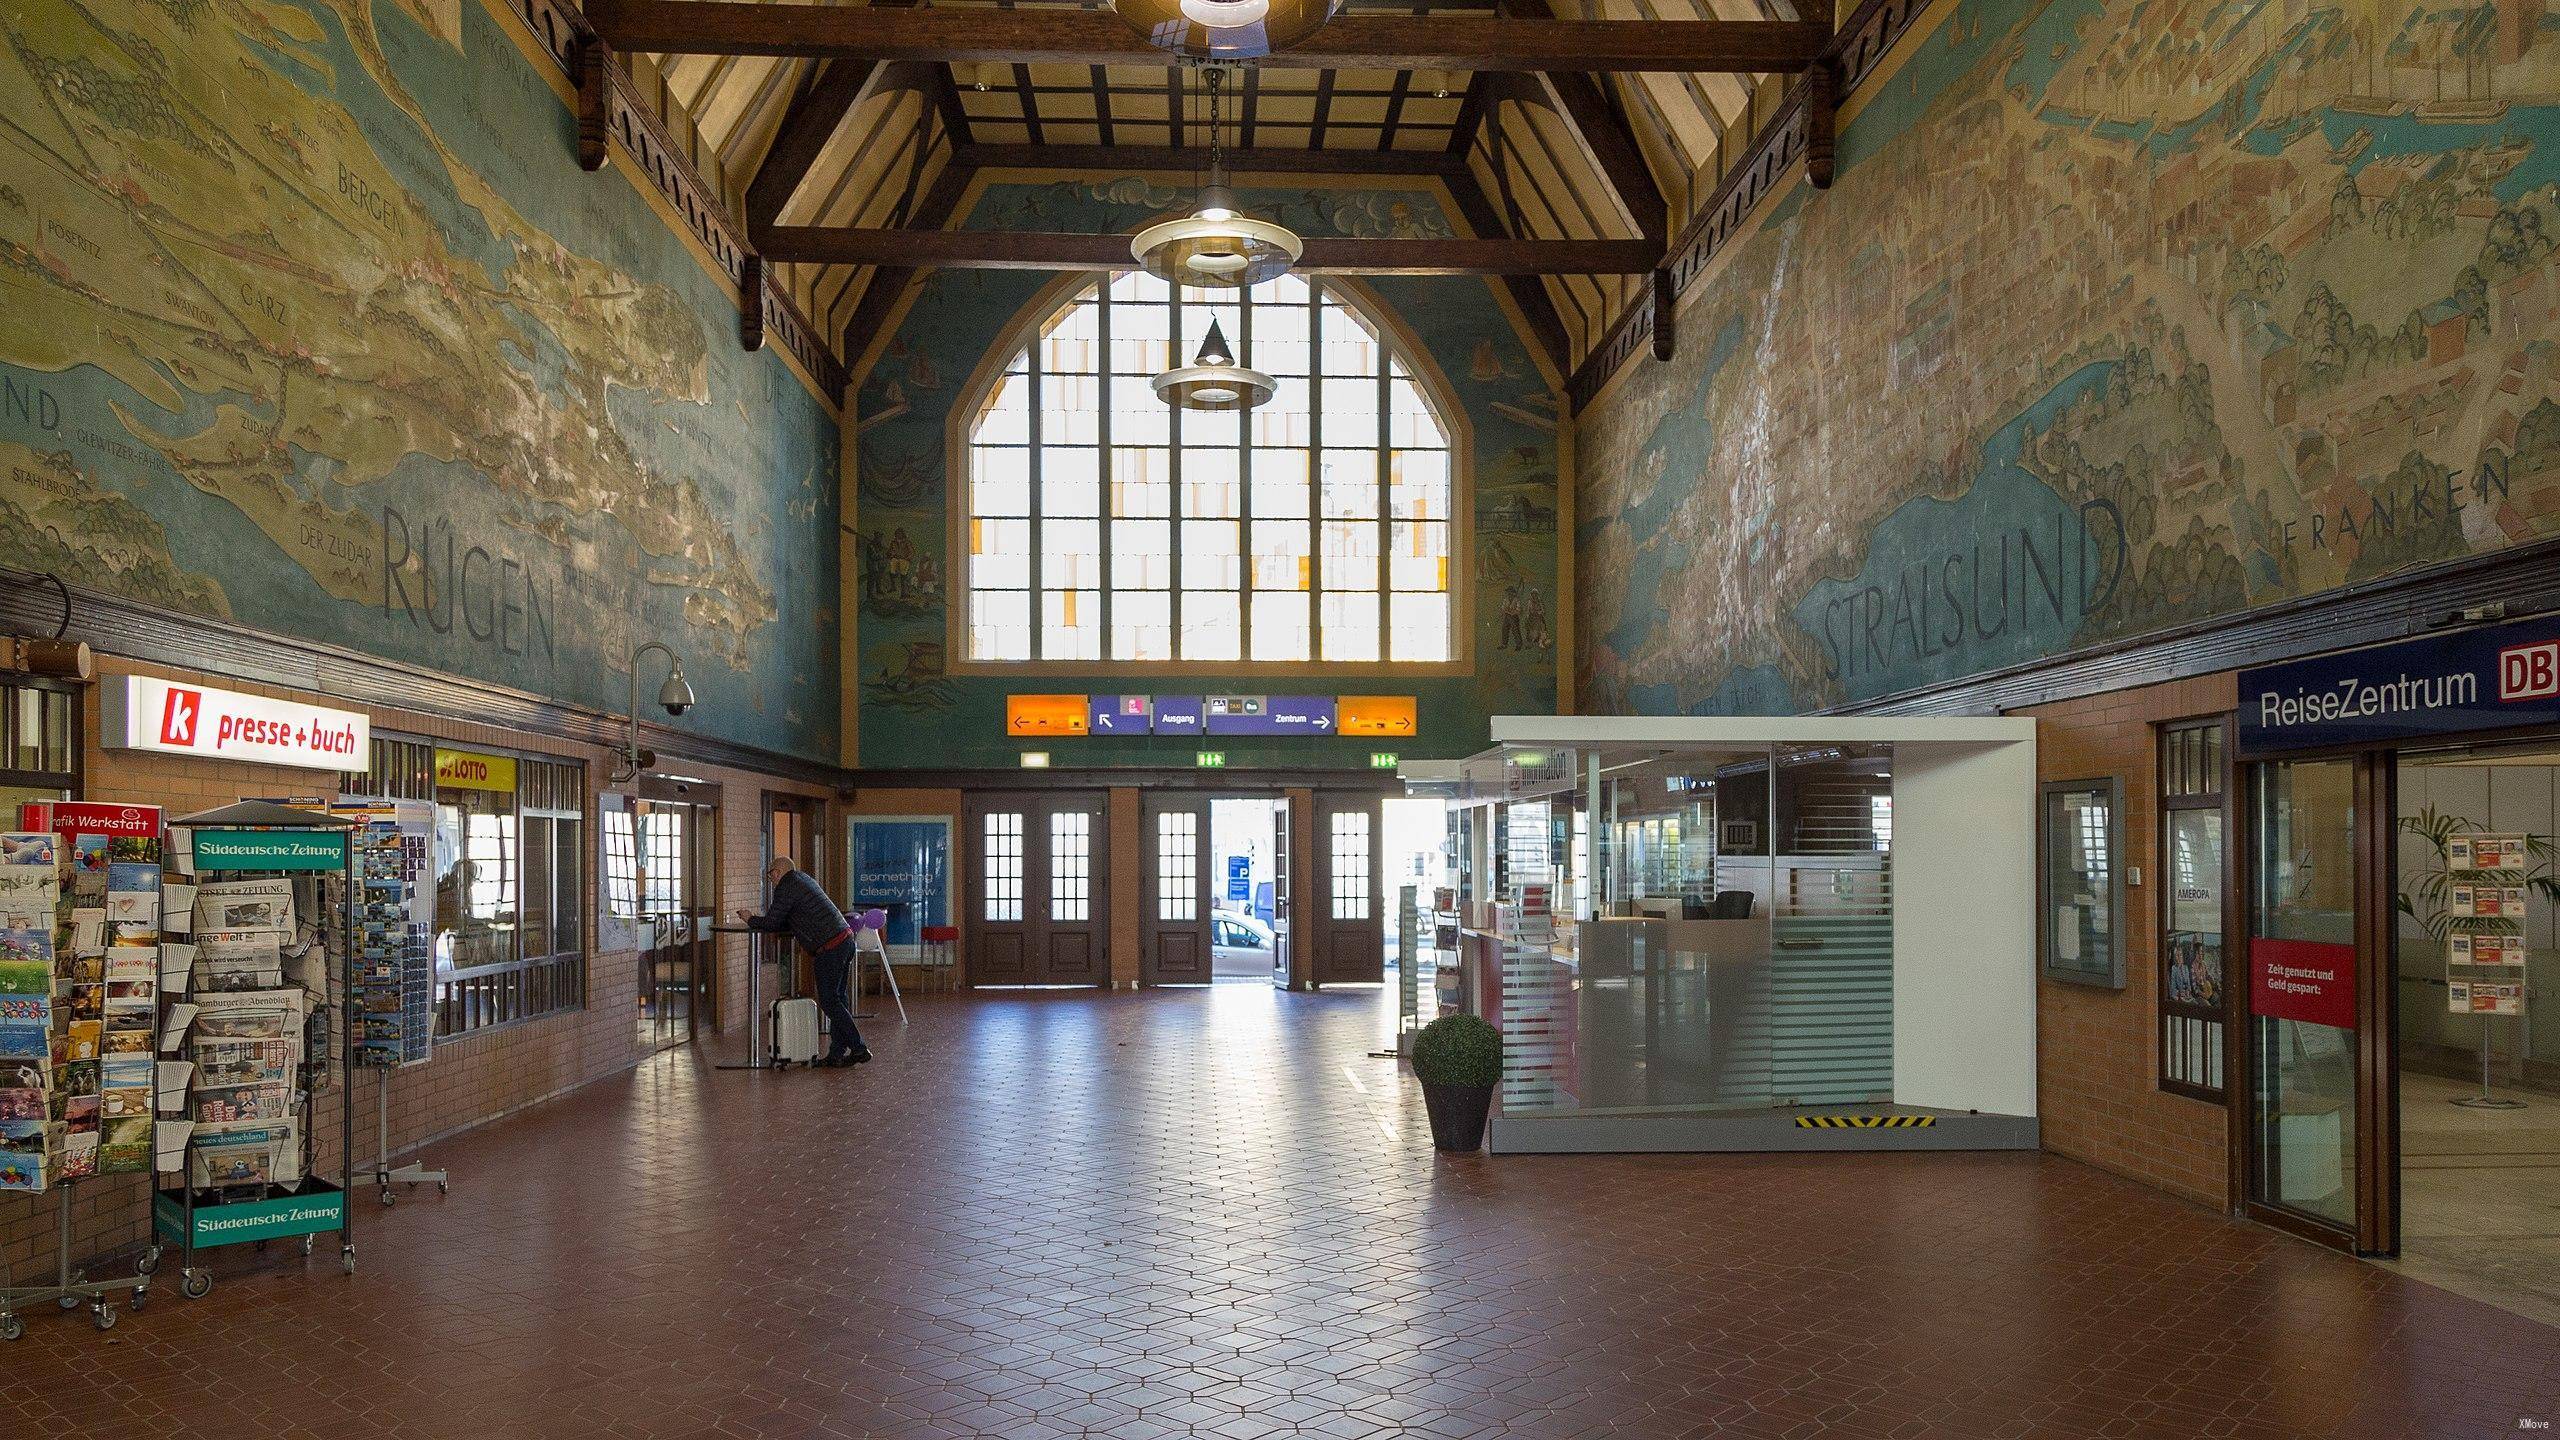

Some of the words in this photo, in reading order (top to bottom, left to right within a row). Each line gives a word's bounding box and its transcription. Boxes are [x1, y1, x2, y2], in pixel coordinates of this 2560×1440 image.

[129, 153, 182, 197] SAMTENS
[337, 160, 405, 239] BERGEN
[47, 219, 103, 260] POSERITZ
[164, 290, 219, 328] SWANTOW
[239, 283, 288, 327] GARZ
[240, 415, 271, 438] ZUDAR
[12, 466, 82, 501] STAHLBRODE
[2283, 455, 2511, 559] FRANKEN
[300, 524, 324, 551] DER
[328, 534, 372, 570] ZUDAR
[382, 504, 556, 669] RÜGEN
[1823, 498, 2127, 682] STRALSUND
[2504, 649, 2555, 695] DB
[2261, 671, 2477, 729] ReiseZentrum
[169, 692, 193, 742] k
[217, 714, 291, 750] presse
[310, 718, 356, 755] buch
[1161, 713, 1196, 725] Ausgang
[1275, 714, 1307, 724] Zentrum
[454, 758, 488, 781] LOTTO
[53, 815, 75, 828] rafik
[78, 816, 149, 831] Werkstatt
[199, 842, 289, 856] Süddeutsche
[290, 843, 342, 860] Zeitung
[860, 871, 933, 884] somethng
[1239, 867, 1249, 878] P
[198, 887, 228, 899] STSEE
[242, 884, 284, 897] ZEITUNG
[860, 886, 904, 898] clearly
[2177, 888, 2211, 901] AMEROPA
[220, 932, 244, 943] Welt
[2267, 963, 2283, 976] Zeit
[2284, 967, 2316, 980] genutzt
[2316, 969, 2334, 981] und
[2267, 978, 2286, 991] Geld
[2286, 980, 2322, 996] gespart:
[218, 1132, 268, 1145] deutschland
[197, 1213, 288, 1233] Süddeutsche
[289, 1206, 340, 1221] Zeitung
